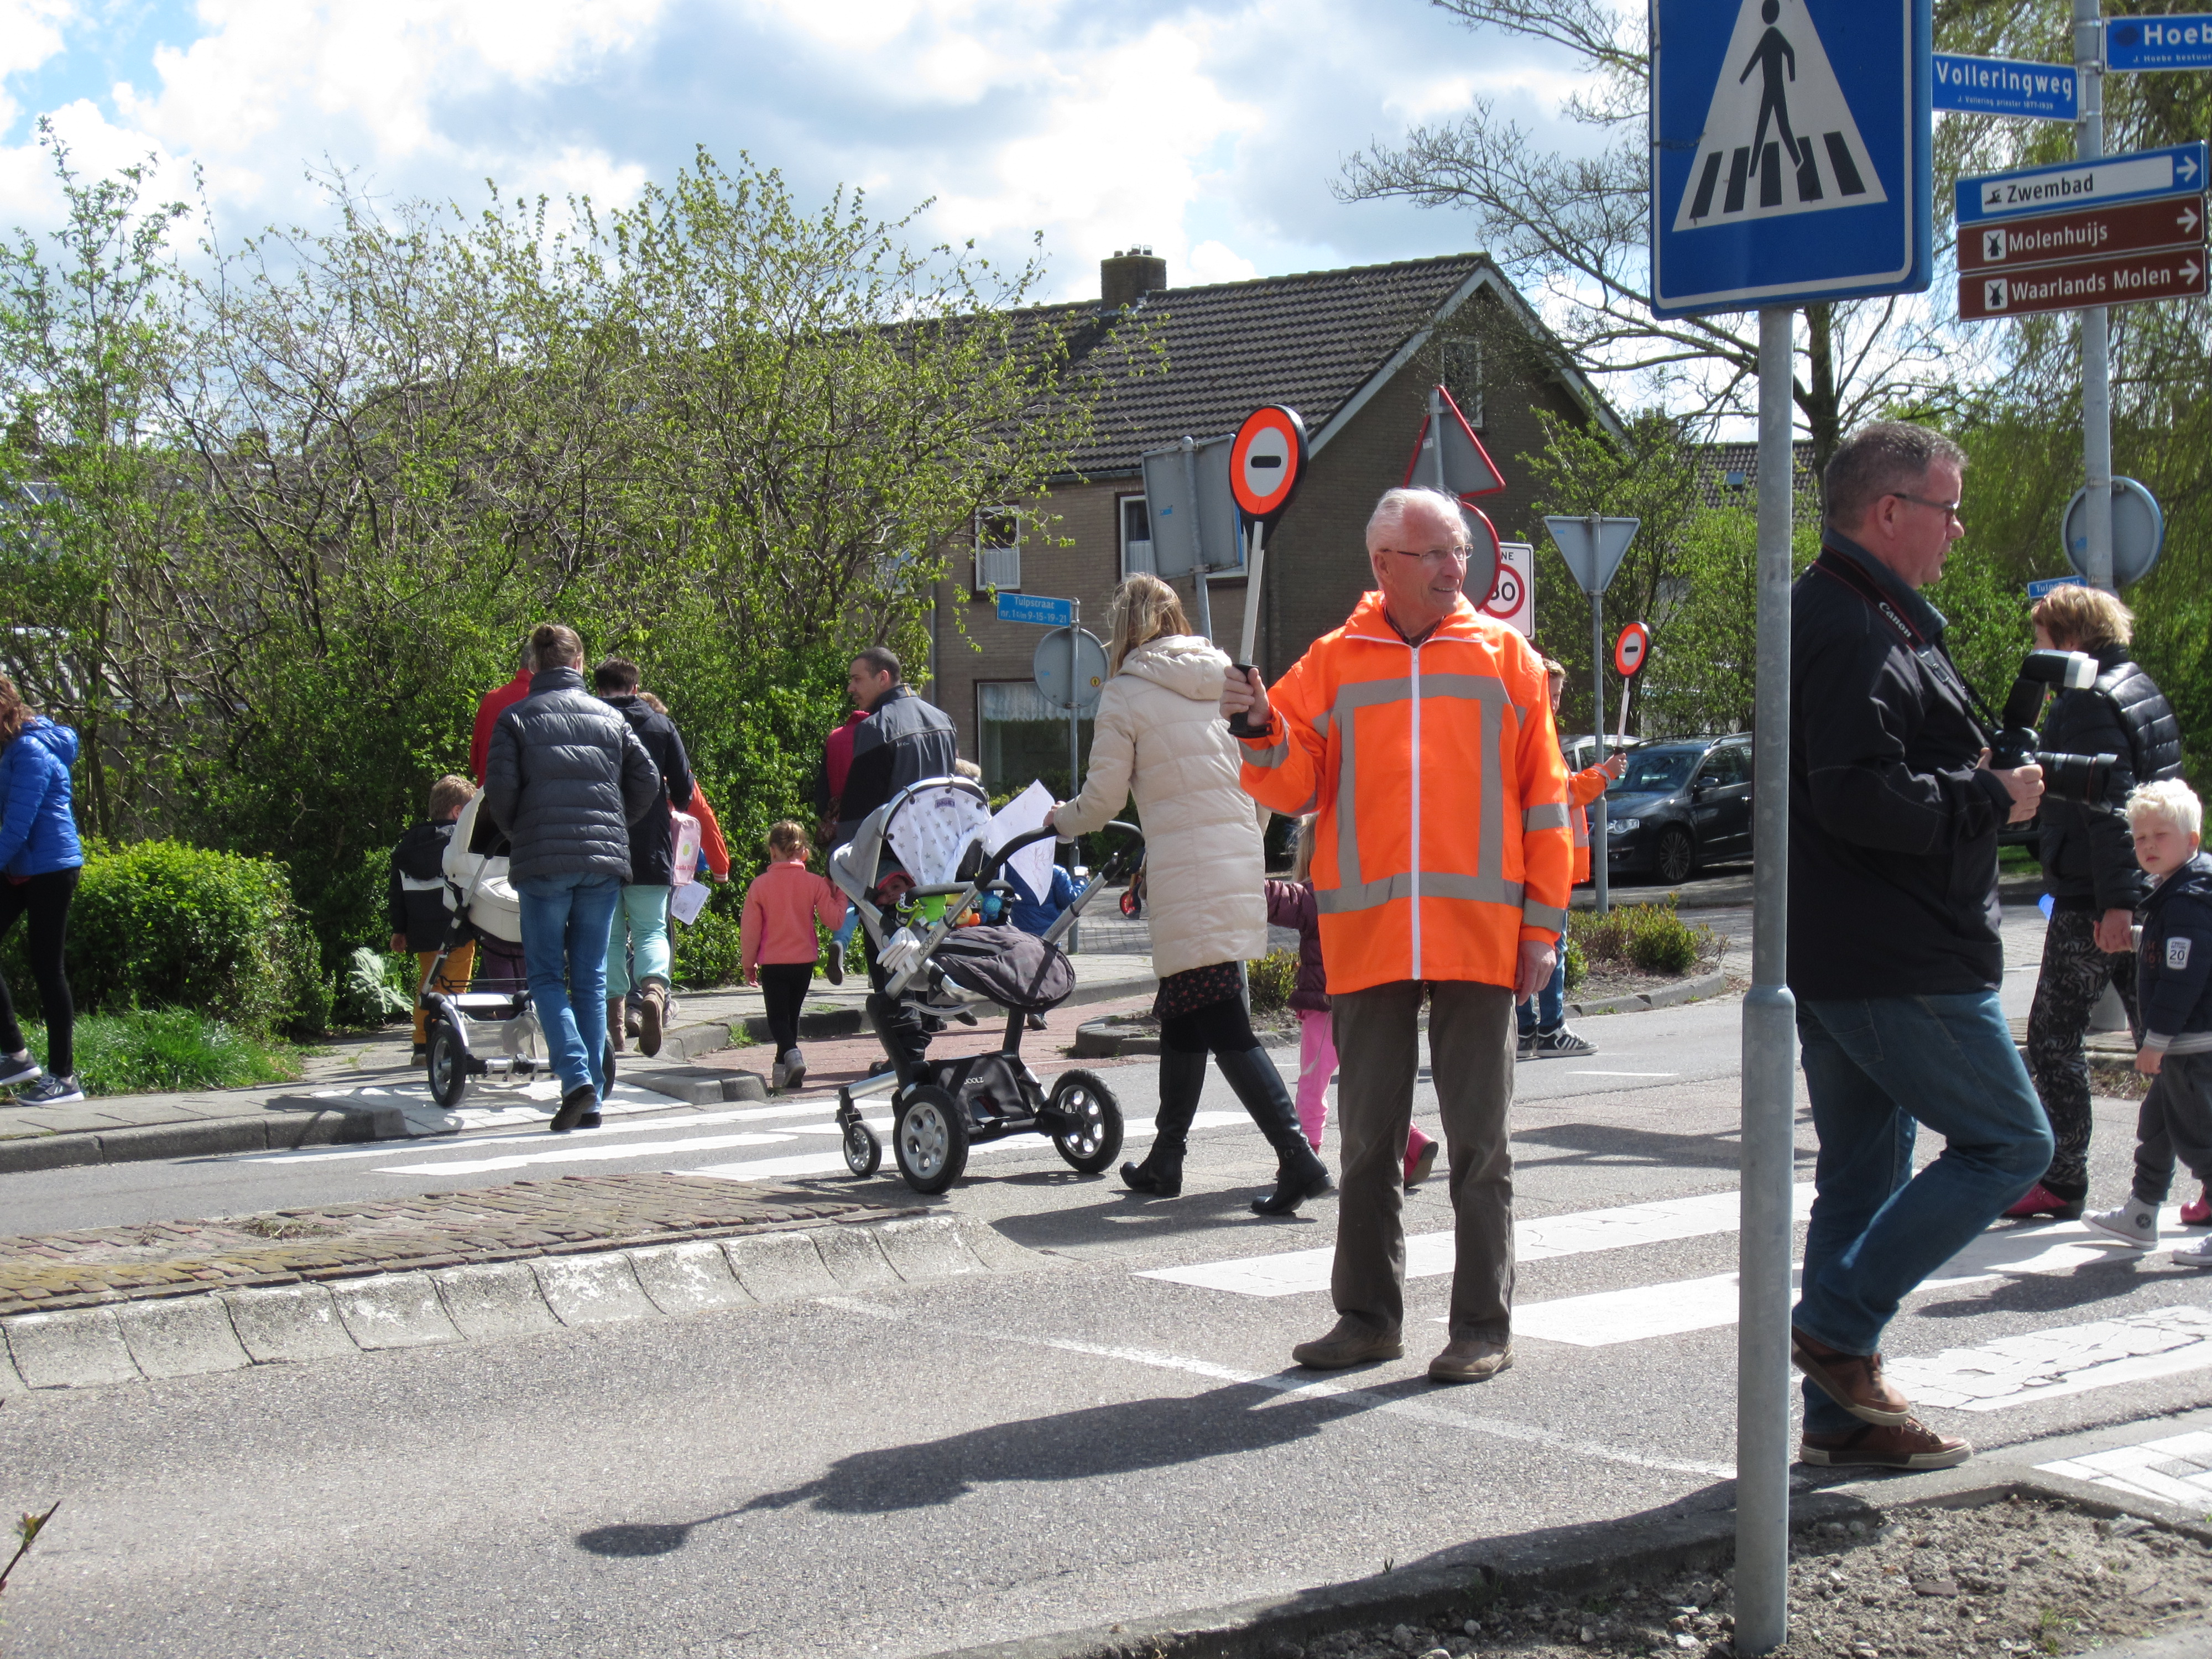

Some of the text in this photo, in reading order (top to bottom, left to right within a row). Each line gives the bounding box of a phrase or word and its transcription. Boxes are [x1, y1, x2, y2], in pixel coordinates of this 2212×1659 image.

[2144, 23, 2212, 45] Hoeb
[1936, 61, 2072, 101] Volleringweg
[2007, 173, 2093, 203] Zwembad
[2010, 222, 2107, 252] Molenhuijs
[2012, 267, 2171, 301] Waarlands Molen
[1501, 551, 1514, 560] NE
[1014, 597, 1055, 609] Tulpstraat
[1879, 602, 1912, 638] Canon
[2169, 950, 2185, 961] 20
[964, 1077, 984, 1085] JOOLZ
